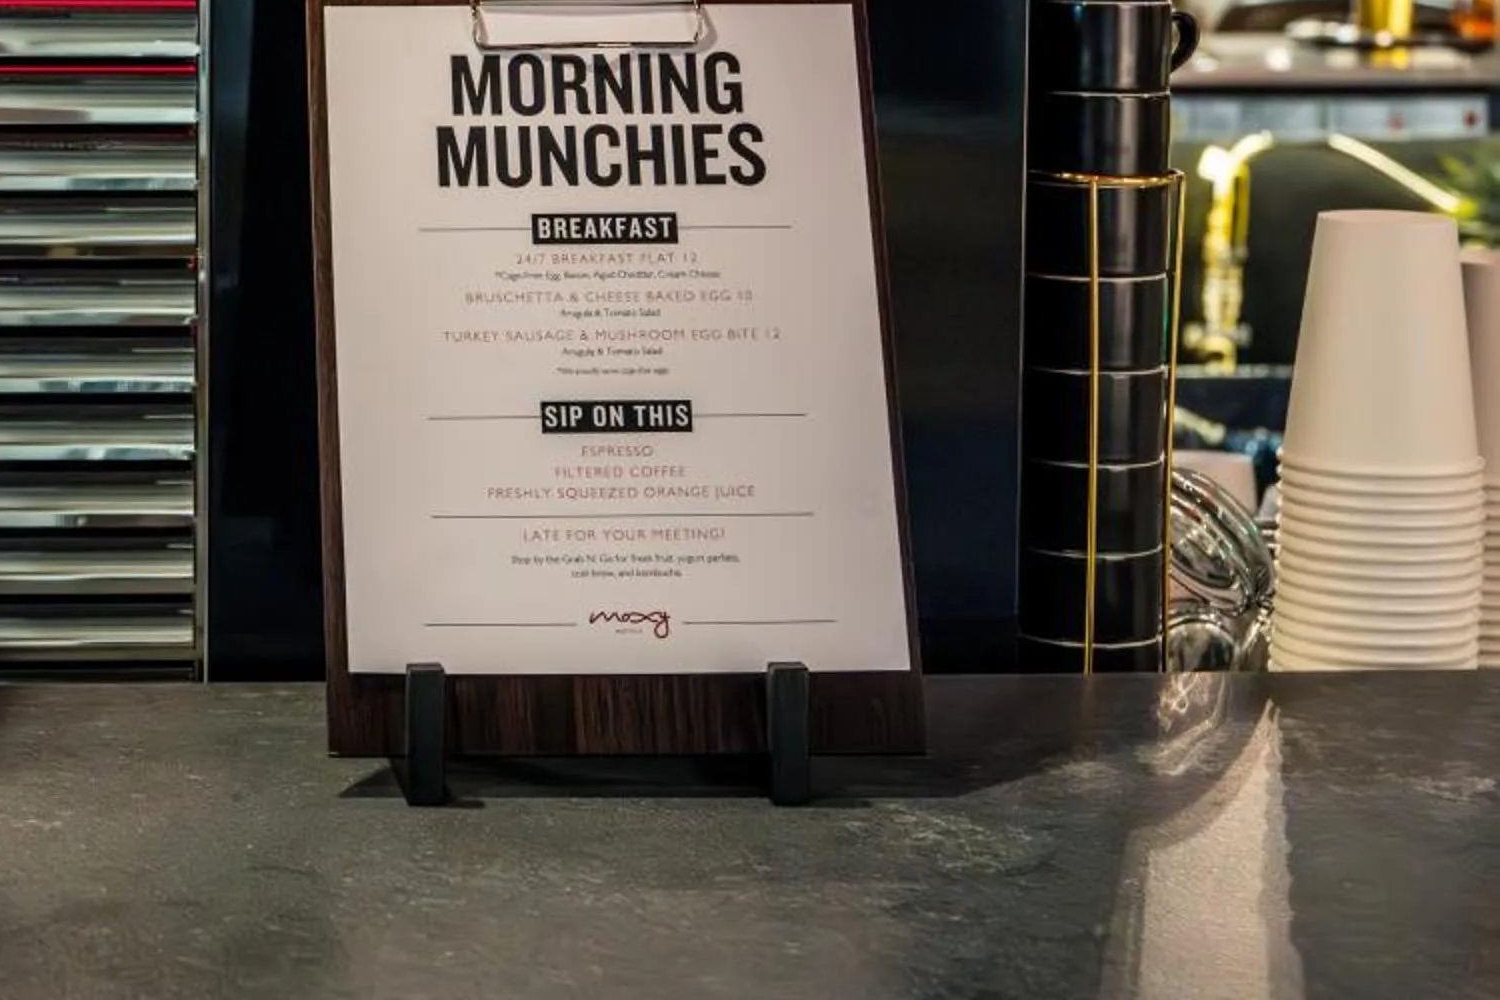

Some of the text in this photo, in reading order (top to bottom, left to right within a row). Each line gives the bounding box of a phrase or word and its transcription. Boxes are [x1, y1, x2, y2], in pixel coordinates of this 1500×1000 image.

[450, 51, 743, 116] MORNING
[436, 122, 767, 188] MUNCHIES
[537, 217, 673, 239] BREAKFAST
[551, 253, 633, 265] BREAKFAST
[640, 252, 675, 264] FLAT
[683, 252, 698, 263] 12
[465, 291, 564, 304] BRUSCHETTA
[584, 291, 640, 303] CHEESE
[646, 291, 696, 303] BAKED
[701, 290, 732, 302] EGG
[443, 331, 499, 343] TURKEY
[505, 330, 574, 342] SAUSAGE
[595, 329, 686, 341] MUSHROOM
[691, 329, 723, 341] EGG
[727, 328, 758, 341] BITE
[544, 404, 690, 428] SIP ON THIS
[581, 445, 655, 457] ESPRESSO
[554, 465, 686, 478] FILTERED COFFEE
[486, 485, 756, 500] FRESHLY SQUEEZED ORANGE JUICE
[523, 529, 560, 542] LATE
[566, 529, 596, 541] FOR
[602, 529, 647, 541] YOUR
[588, 611, 671, 639] moxy
